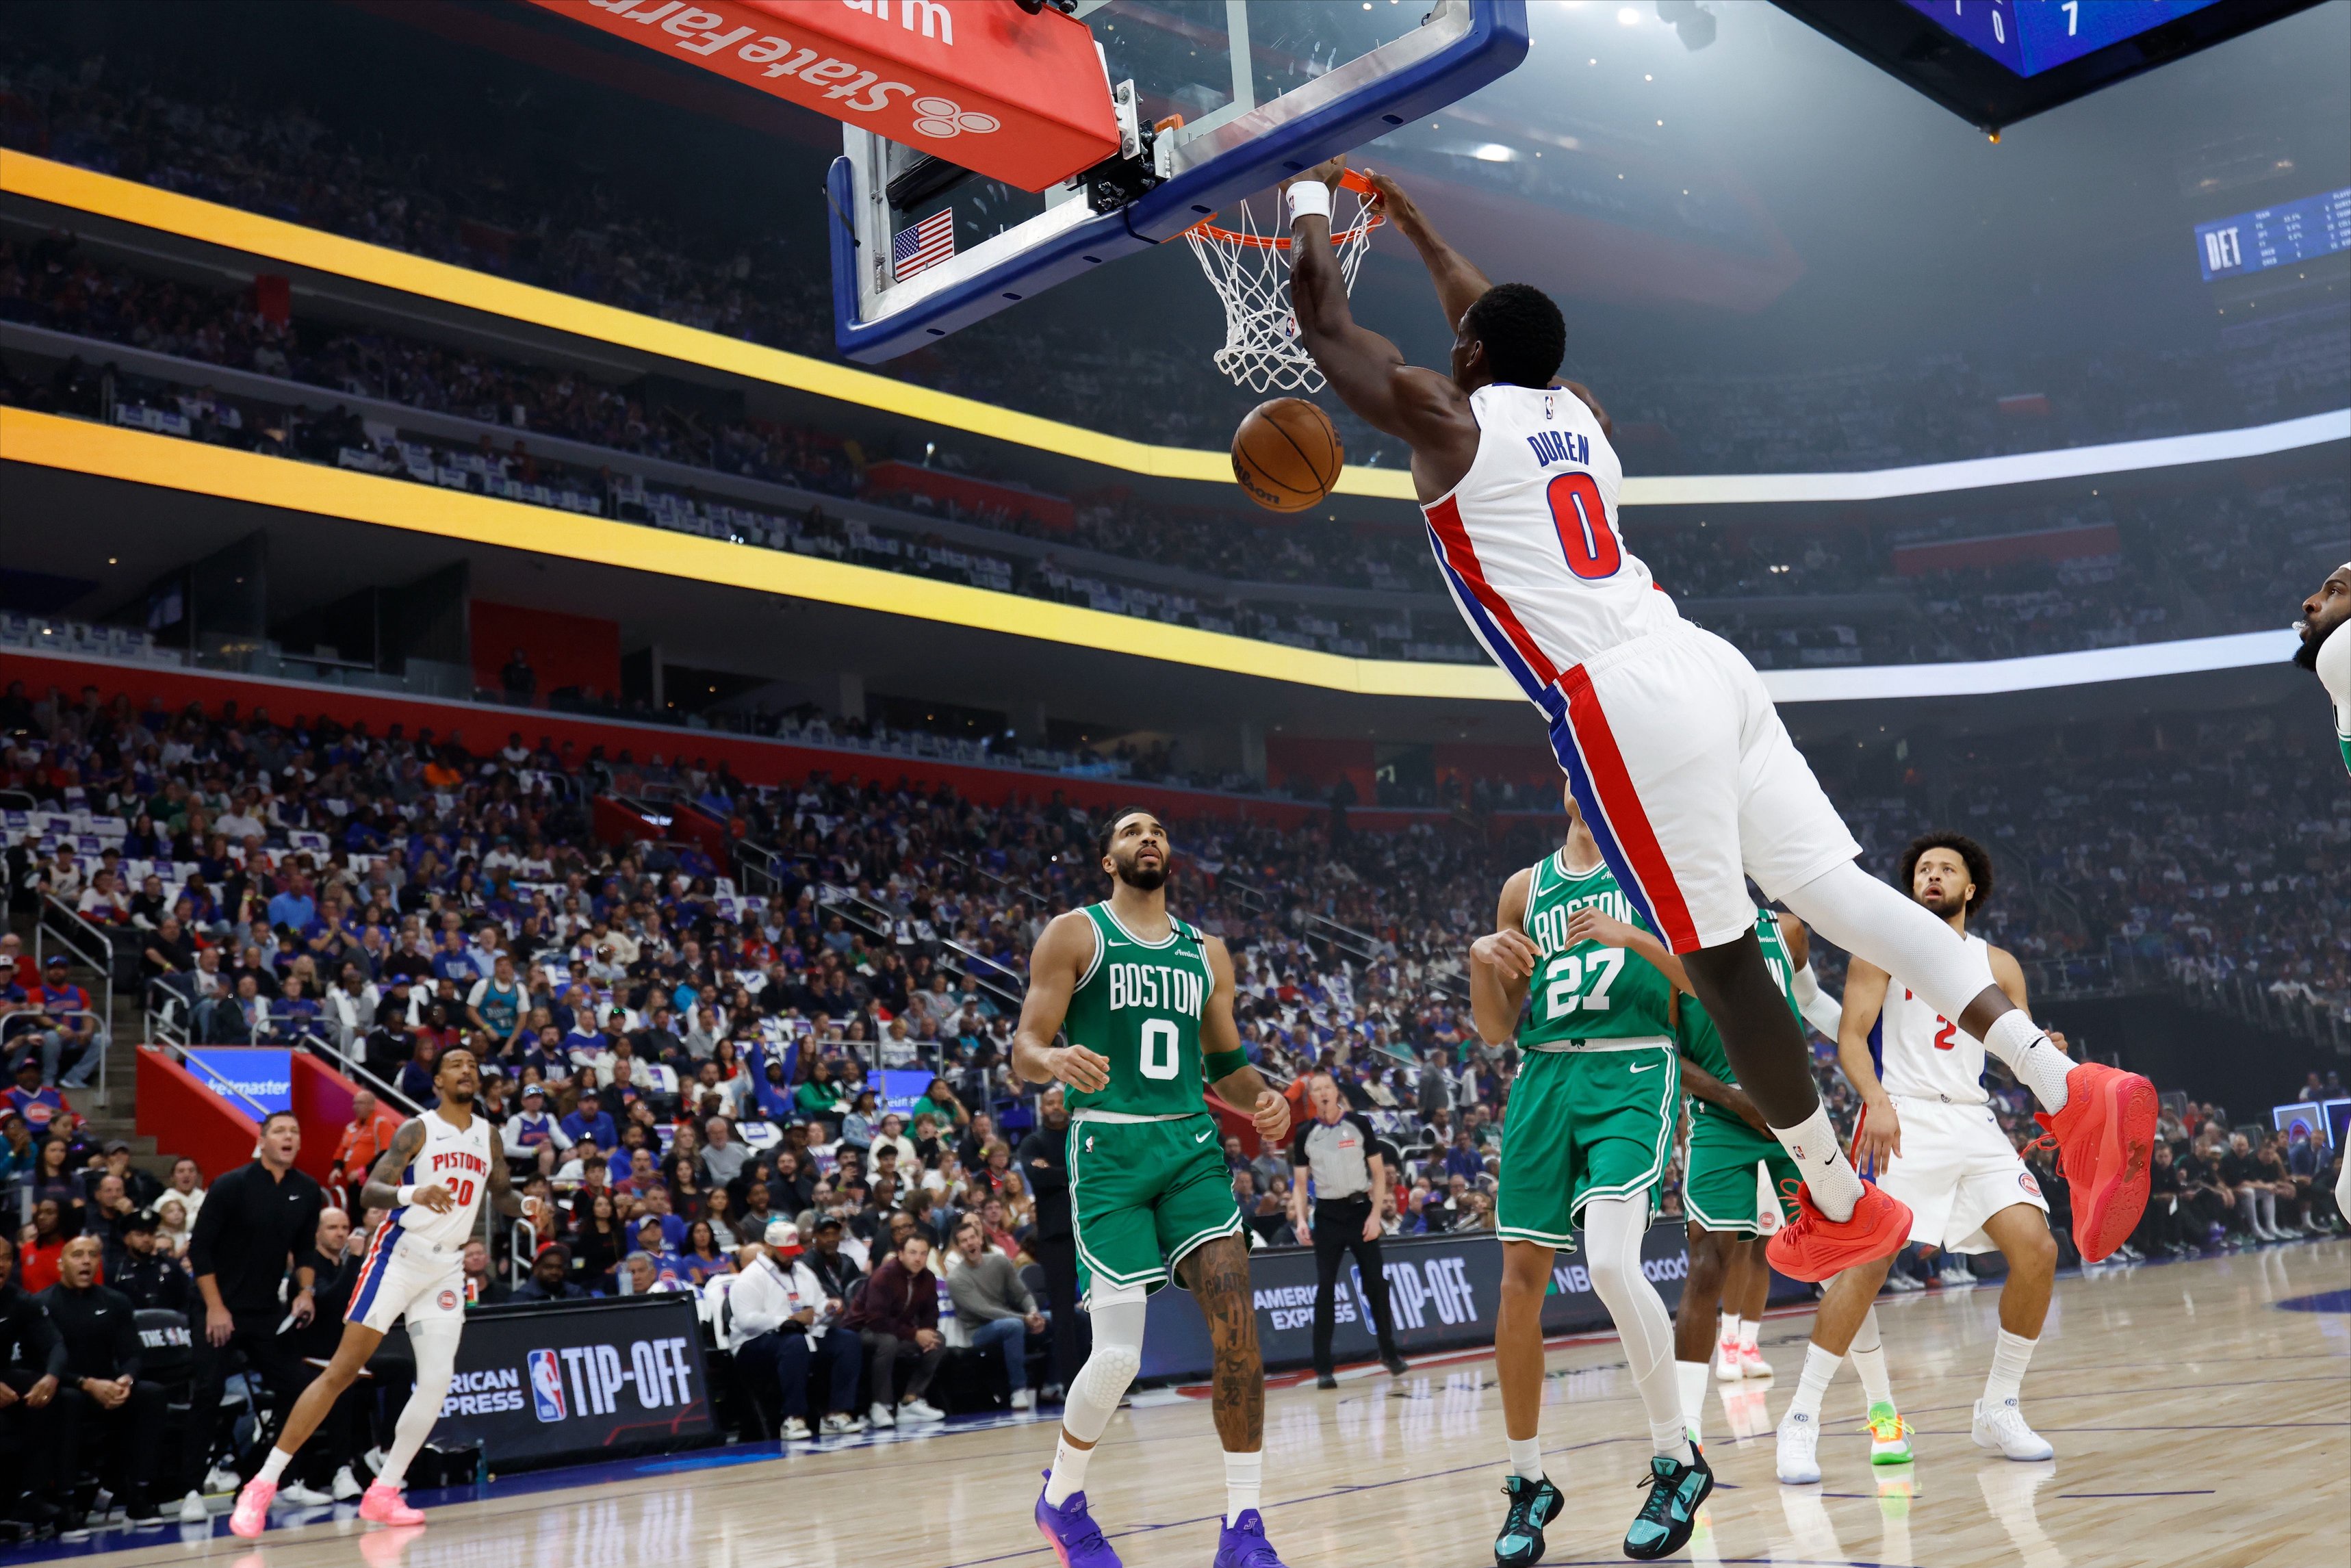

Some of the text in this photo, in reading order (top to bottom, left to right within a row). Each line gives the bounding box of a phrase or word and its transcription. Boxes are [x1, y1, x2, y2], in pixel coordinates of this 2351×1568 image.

[1992, 10, 2005, 44] 0
[2205, 227, 2241, 271] DET
[1527, 431, 1590, 467] DUREN
[1547, 471, 1621, 580] 0
[1174, 949, 1199, 960] Amica
[1109, 963, 1203, 1021] BOSTON
[1546, 948, 1625, 1020] 27
[1140, 1018, 1179, 1080] 0
[1934, 1014, 1957, 1051] 2
[433, 1153, 487, 1178] PISTONS
[446, 1177, 474, 1206] 20
[1253, 1281, 1349, 1310] AMERIN
[1383, 1257, 1478, 1331] TIP-OFF
[1270, 1302, 1357, 1331] EXPSS
[561, 1337, 691, 1417] TIP-OFF
[438, 1390, 526, 1418] PRESS
